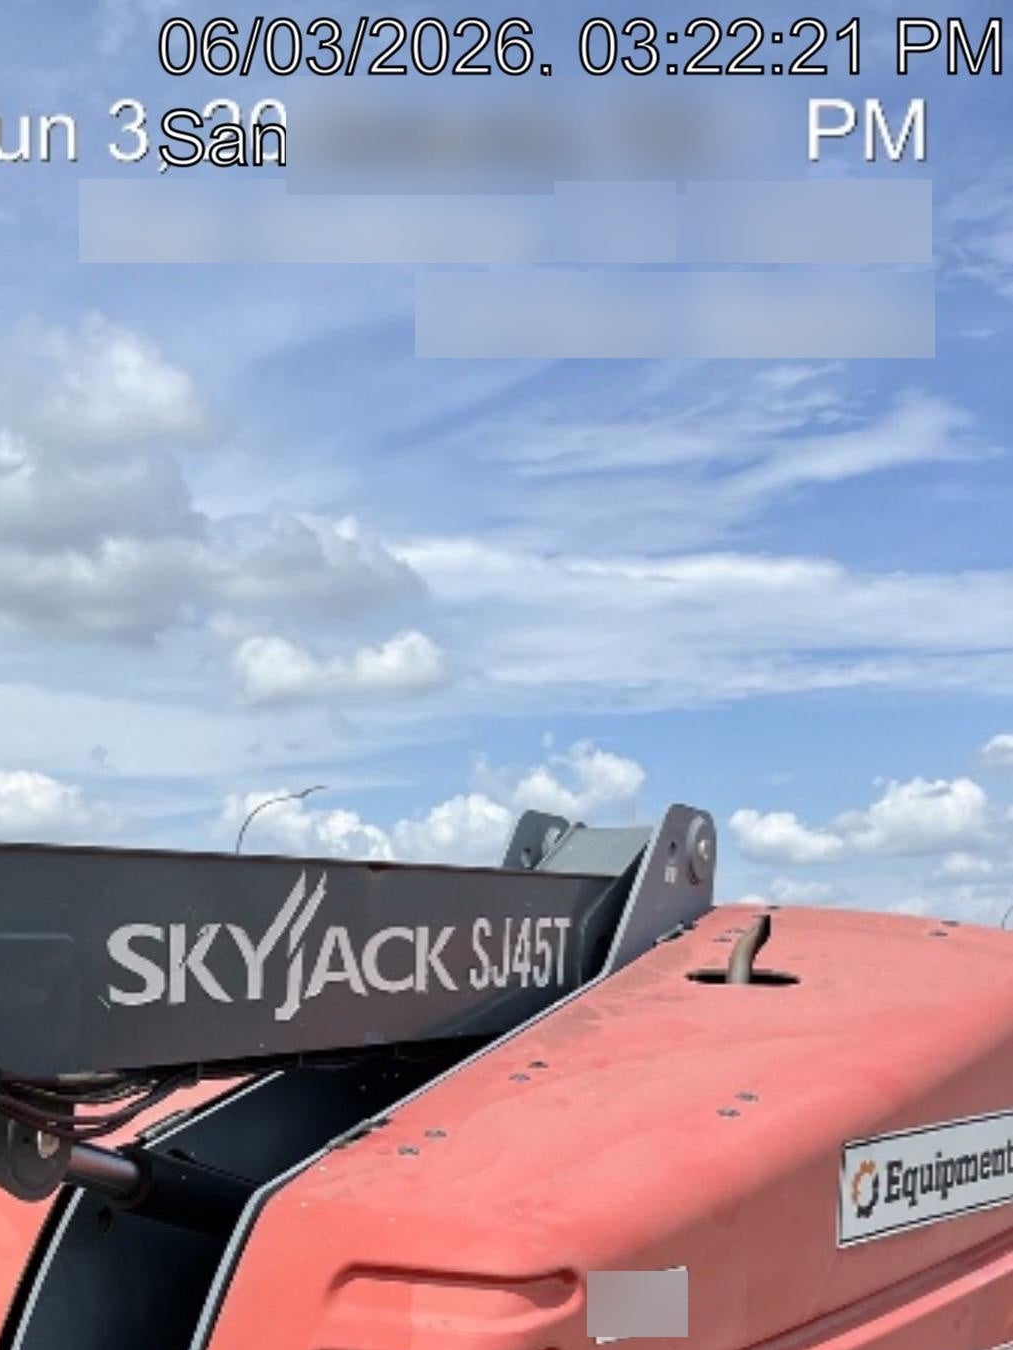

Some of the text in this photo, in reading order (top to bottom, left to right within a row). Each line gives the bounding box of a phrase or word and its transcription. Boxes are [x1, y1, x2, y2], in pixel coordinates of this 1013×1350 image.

[105, 869, 572, 1021] SKYJACK SJ45T
[884, 1139, 1013, 1207] Equipment
